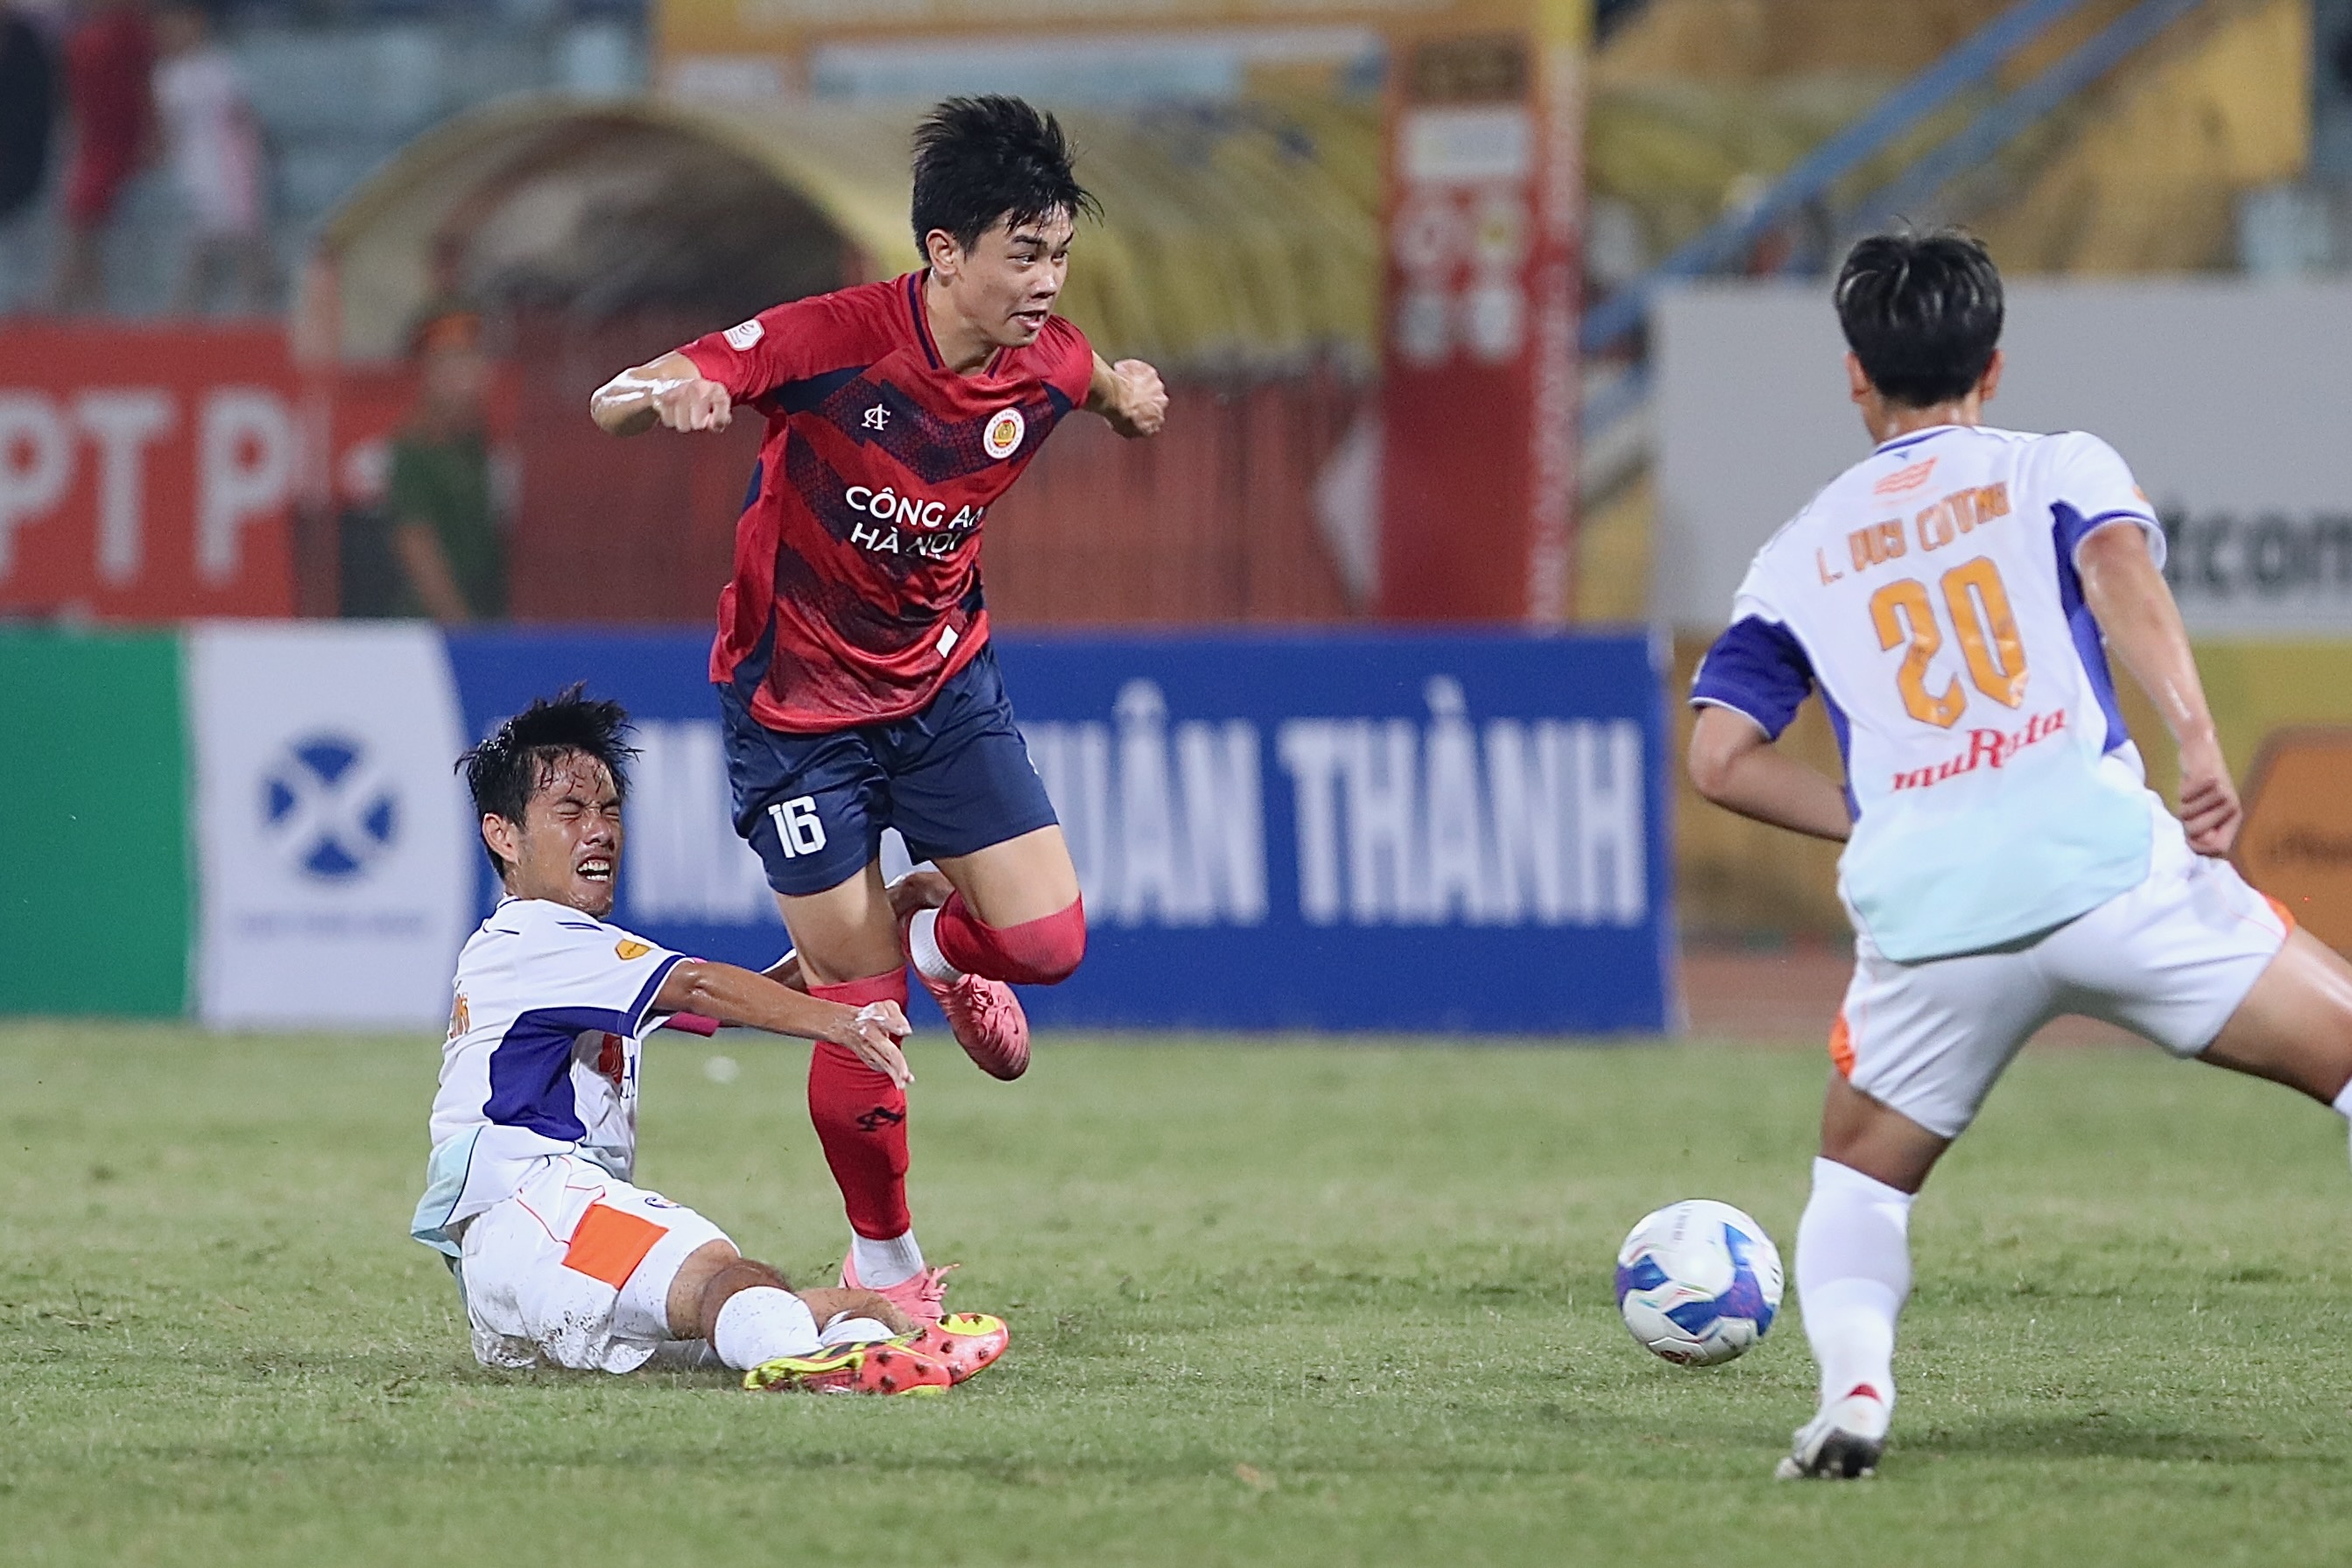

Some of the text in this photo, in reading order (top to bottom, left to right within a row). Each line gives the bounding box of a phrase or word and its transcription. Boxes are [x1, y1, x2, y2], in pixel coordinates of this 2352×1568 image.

[846, 486, 946, 527] CÔNG
[850, 523, 898, 553] HÀ
[1869, 555, 2029, 728] 20
[767, 795, 827, 859] 16
[1011, 678, 1268, 926] UÂN
[1277, 674, 1646, 926] THÀNH
